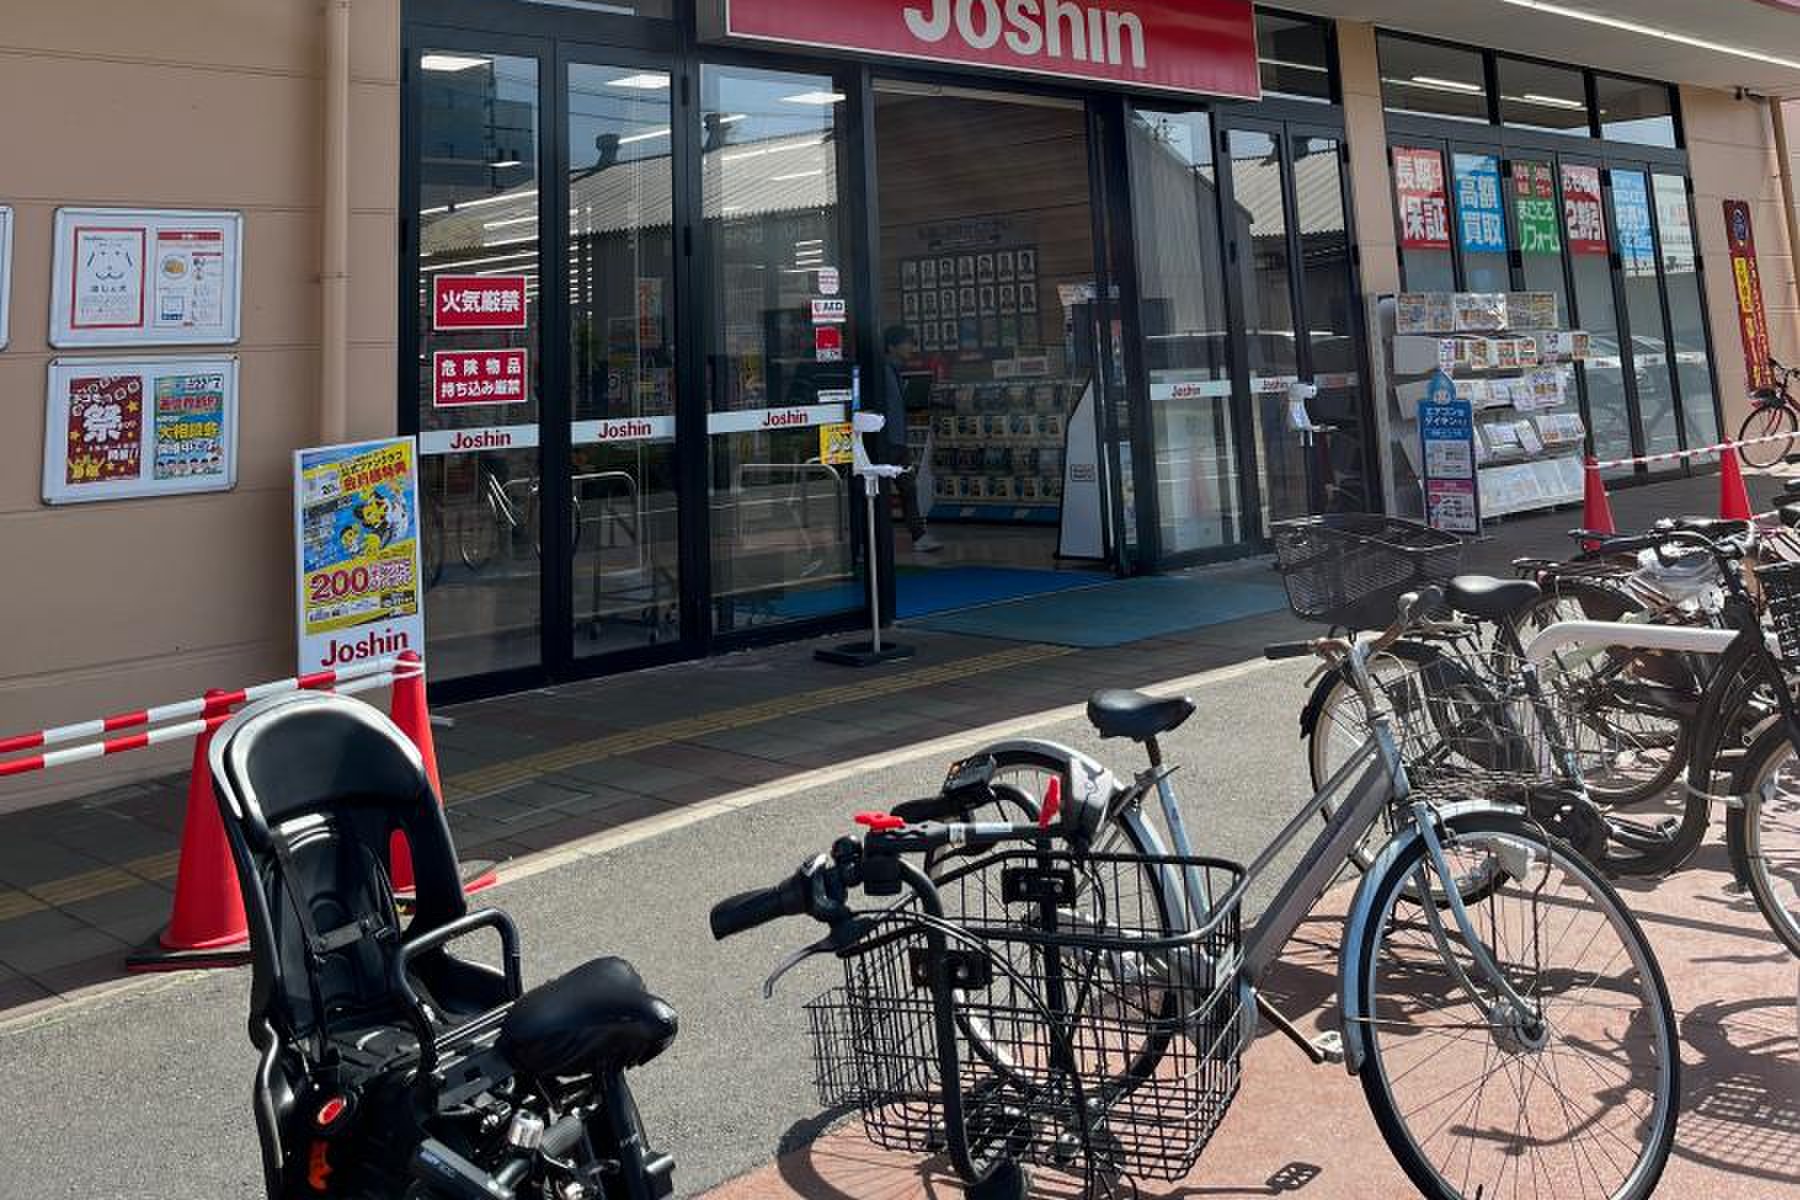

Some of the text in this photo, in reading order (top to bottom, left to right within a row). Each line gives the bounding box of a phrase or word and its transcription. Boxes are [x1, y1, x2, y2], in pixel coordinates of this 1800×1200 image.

[1459, 175, 1498, 209] 高額
[1400, 195, 1447, 240] 保証
[1462, 211, 1503, 246] 買取
[442, 289, 521, 313] 火気厳禁
[441, 357, 521, 377] 危険物品
[441, 379, 521, 399] 持ち込み厳禁
[598, 420, 652, 440] Joshin
[762, 409, 809, 428] Joshin
[450, 431, 512, 450] Joshin
[311, 566, 369, 601] 200
[321, 628, 409, 667] Joshin
